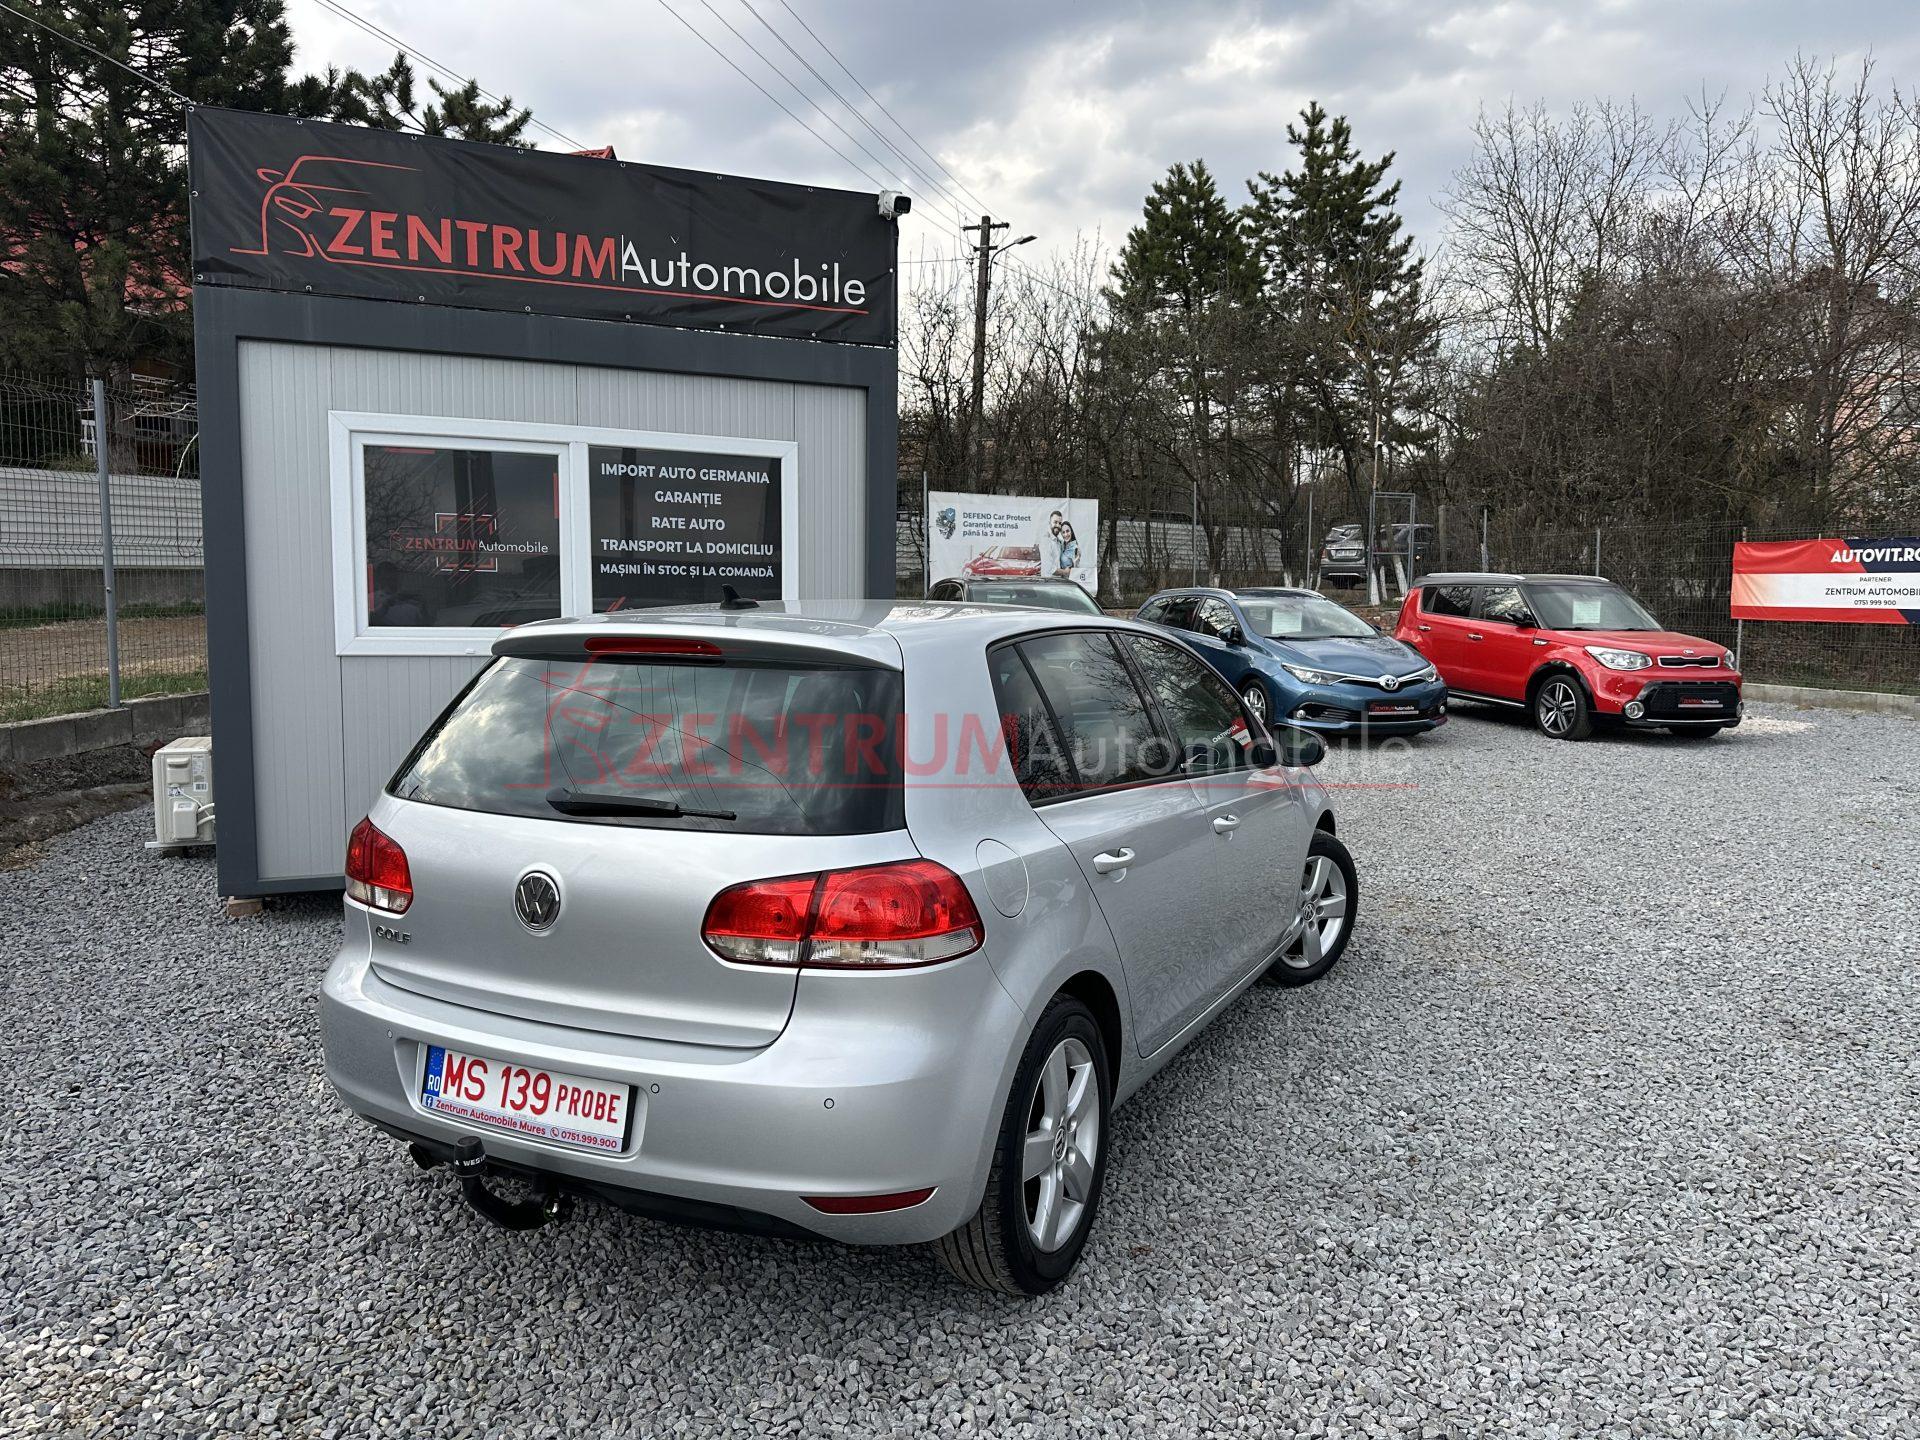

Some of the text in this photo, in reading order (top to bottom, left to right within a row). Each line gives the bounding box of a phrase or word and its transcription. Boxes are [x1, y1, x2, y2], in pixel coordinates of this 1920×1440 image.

[327, 207, 866, 305] ZENTRUM Automobile
[601, 463, 770, 484] IMPORT AUTO GERMANIA
[654, 491, 722, 508] GARANȚIE
[652, 517, 726, 531] RATE AUTO
[962, 512, 992, 520] DEFEND
[600, 539, 773, 555] TRANSPORT LA DOMICILIU
[600, 562, 774, 578] MAȘINI ÎN STOC ȘI LA COMANDĂ
[1825, 588, 1865, 596] ZENTRUM
[376, 925, 411, 944] GOLF
[428, 1075, 440, 1092] RO
[443, 1054, 621, 1123] MS 139 PROBE
[436, 1099, 468, 1116] Zentrum
[470, 1109, 518, 1128] Automobile
[519, 1121, 546, 1135] Mures
[561, 1131, 617, 1148] 0751.999.900
